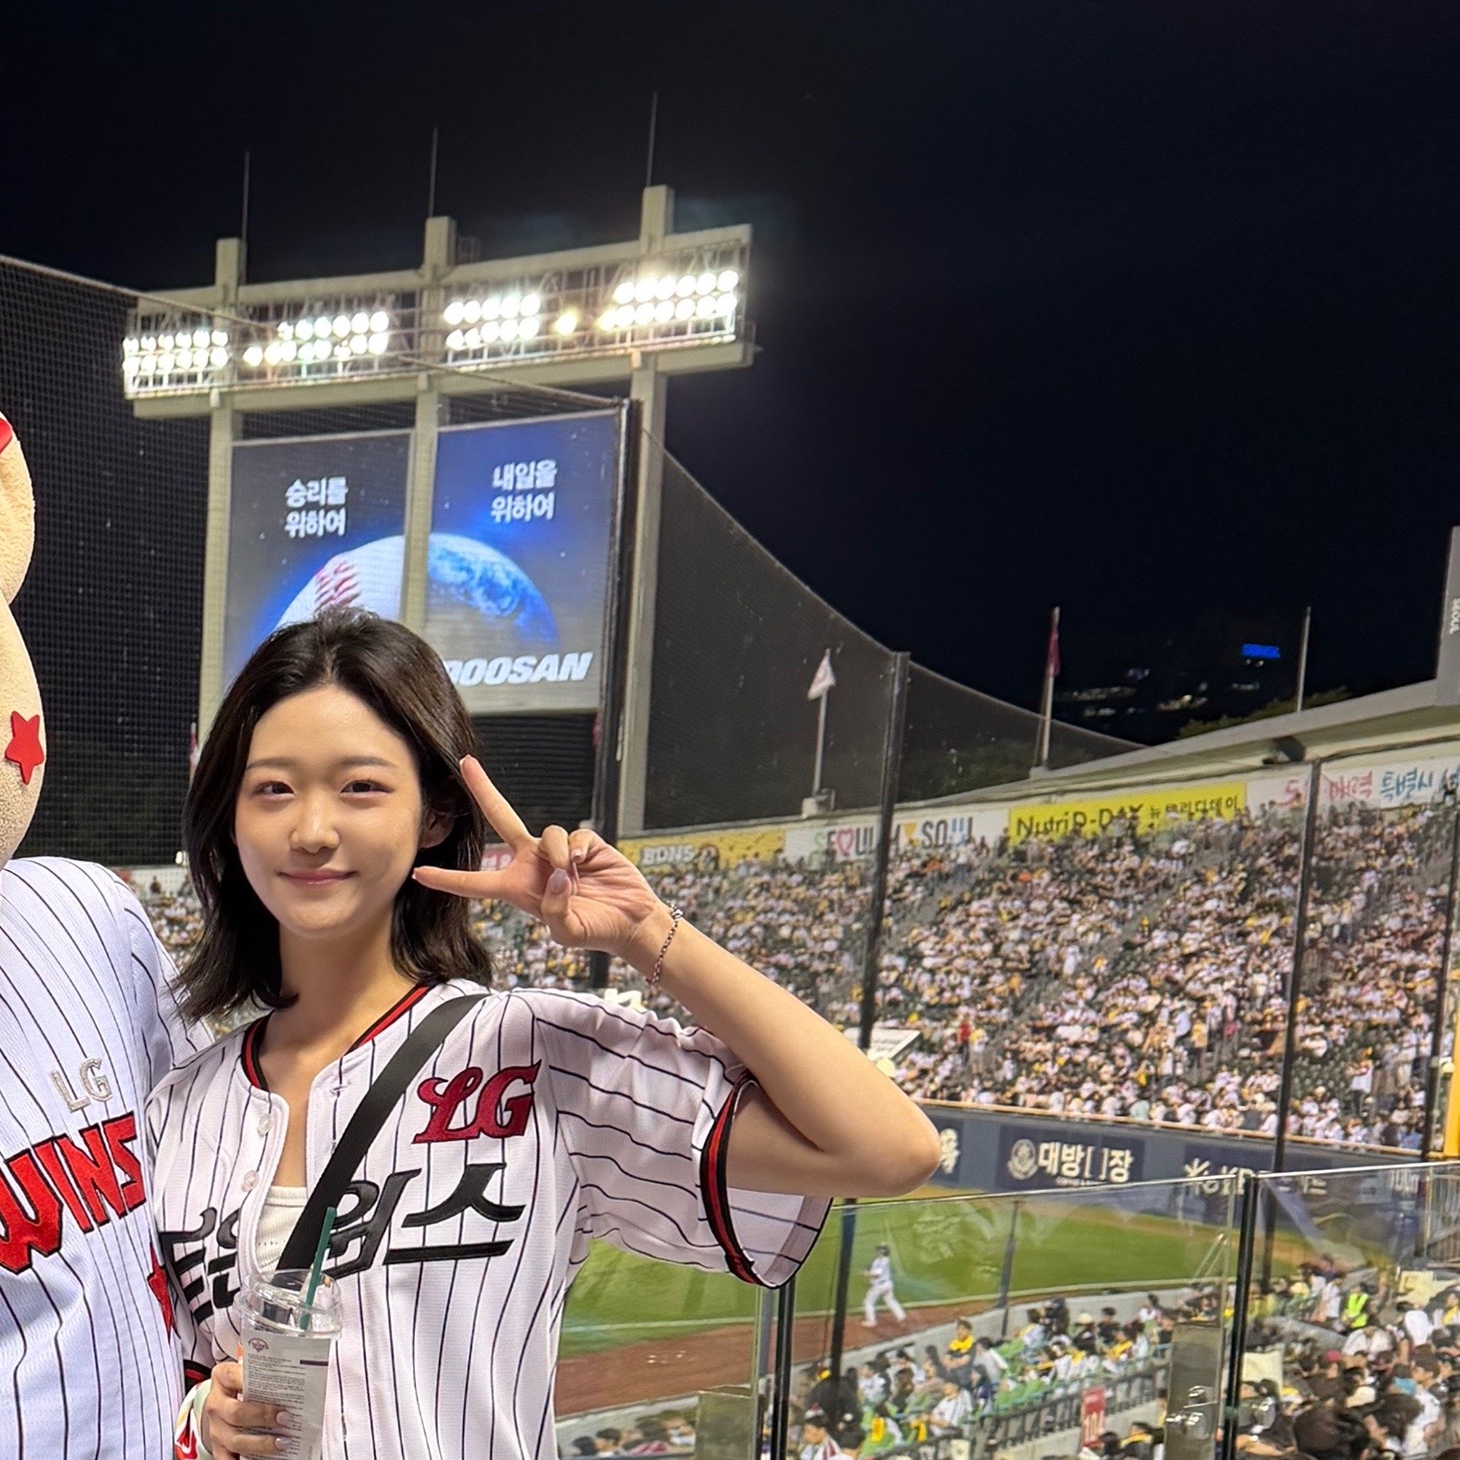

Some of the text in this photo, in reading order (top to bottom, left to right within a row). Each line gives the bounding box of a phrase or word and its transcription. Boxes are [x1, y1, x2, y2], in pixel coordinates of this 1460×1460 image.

[492, 459, 558, 491] 내일을
[285, 476, 349, 507] 승리를
[491, 491, 556, 523] 위하여
[284, 508, 346, 538] 위하여
[49, 1056, 114, 1113] LG
[412, 1060, 542, 1145] LG
